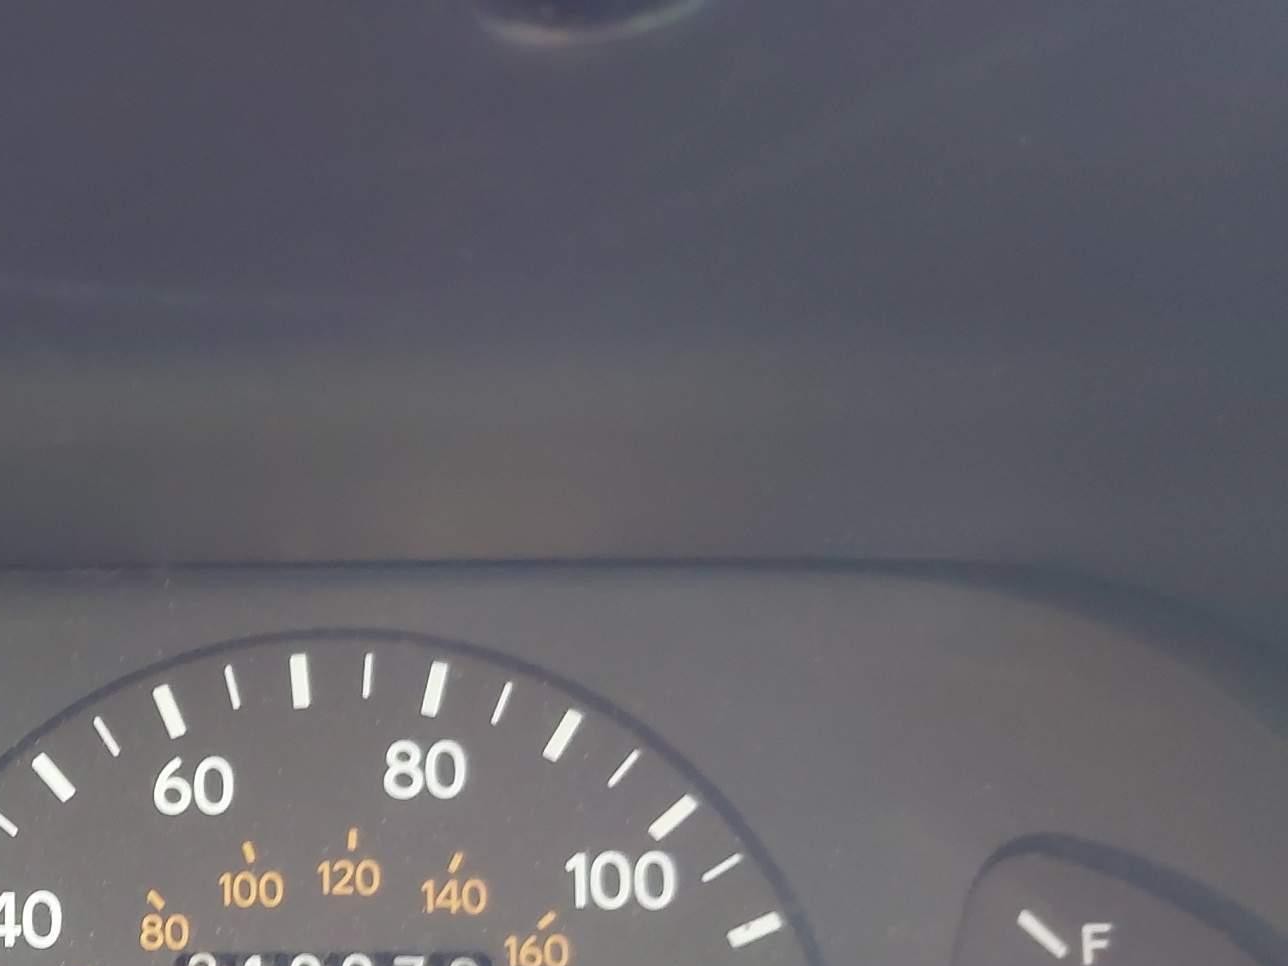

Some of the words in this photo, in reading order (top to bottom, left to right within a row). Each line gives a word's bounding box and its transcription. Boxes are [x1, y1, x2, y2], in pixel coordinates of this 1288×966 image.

[153, 756, 234, 816] 60
[383, 739, 467, 800] 80
[219, 871, 284, 908] 100
[317, 859, 381, 896] 120
[421, 879, 488, 915] 140
[565, 850, 676, 910] 100
[140, 914, 189, 951] 80
[1081, 923, 1112, 966] F
